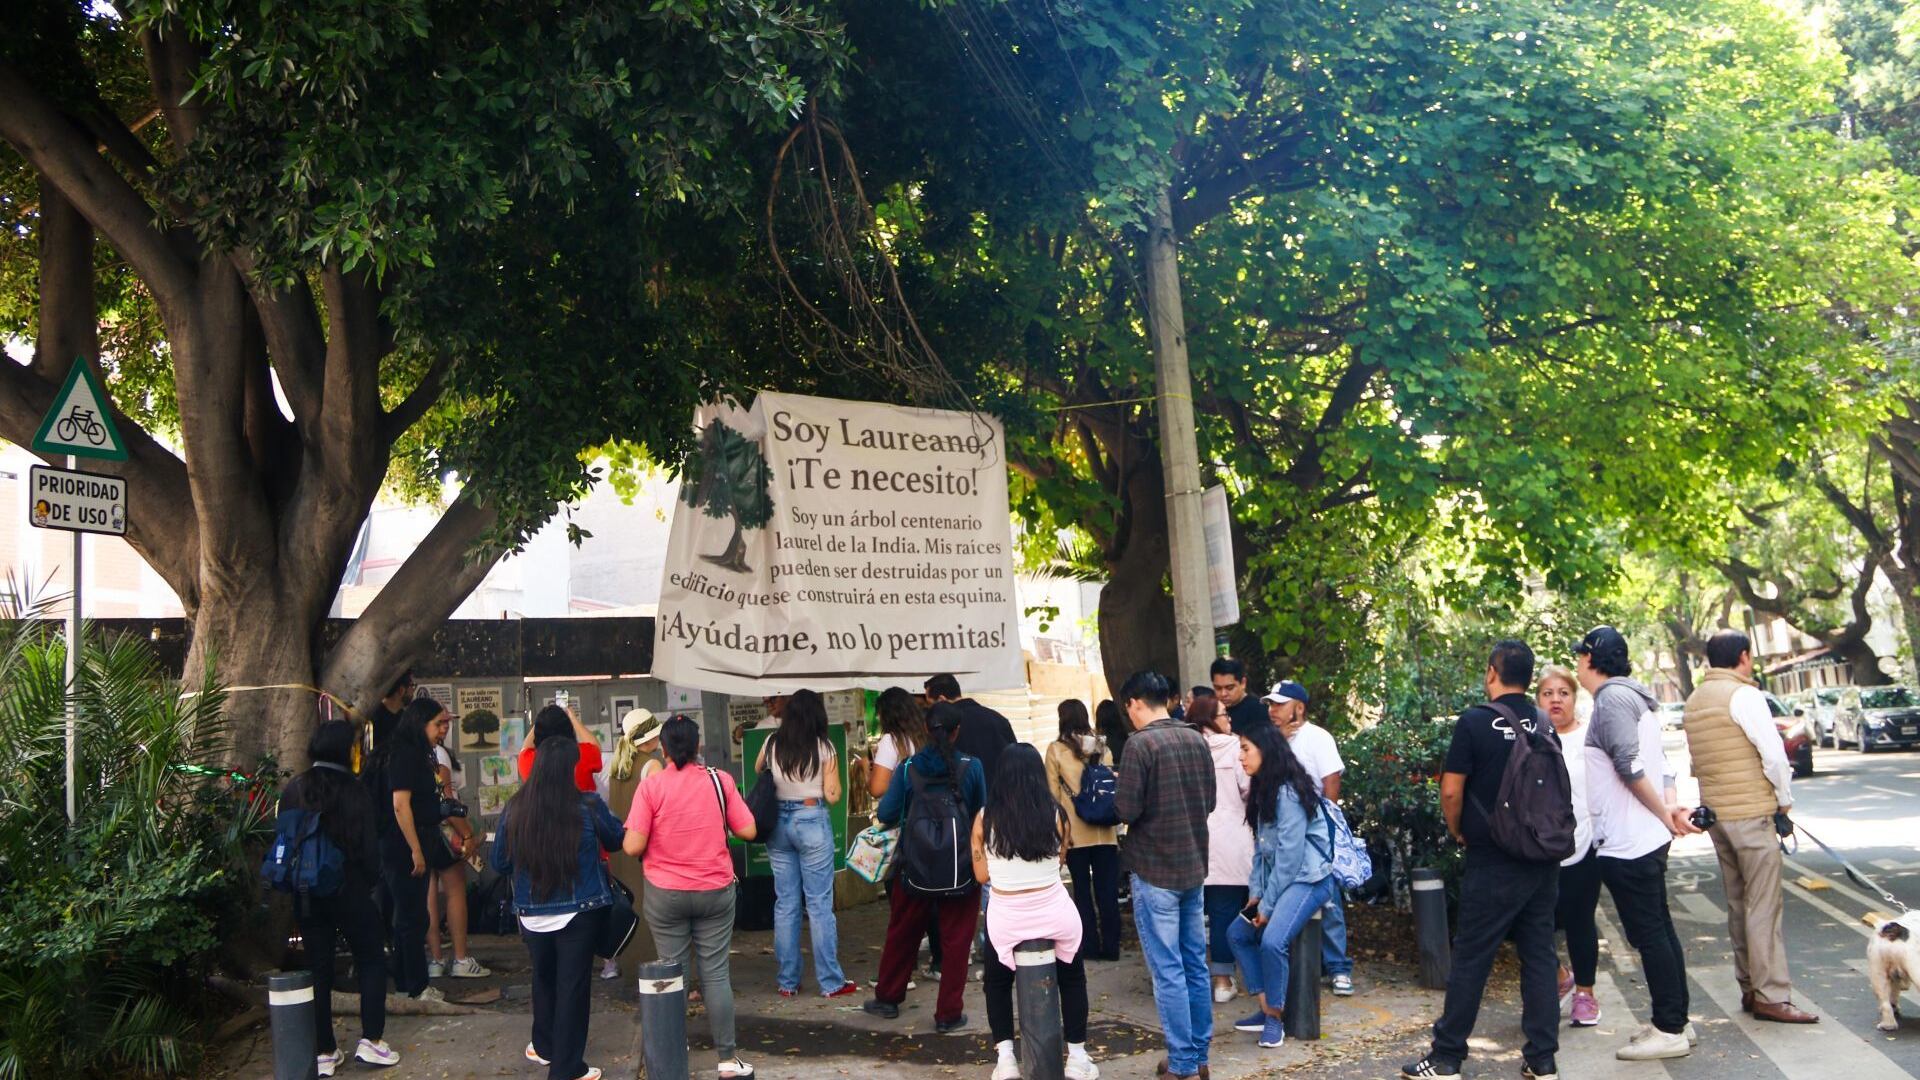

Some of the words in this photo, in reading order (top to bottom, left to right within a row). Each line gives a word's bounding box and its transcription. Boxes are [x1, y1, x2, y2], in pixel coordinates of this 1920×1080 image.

[773, 411, 830, 452] Soy
[838, 418, 985, 460] Laureano,
[39, 474, 119, 501] PRIORIDAD
[787, 457, 841, 489] ¡Te
[850, 465, 978, 496] necesito!
[52, 503, 71, 521] DE
[79, 506, 107, 526] USO
[791, 506, 818, 530] Soy
[822, 514, 845, 527] un
[850, 510, 896, 528] árbol
[900, 514, 982, 530] centenario
[776, 531, 823, 551] laurel
[826, 534, 846, 553] de
[851, 535, 867, 553] la
[872, 536, 920, 554] India.
[924, 538, 952, 554] Mis
[956, 539, 1001, 555] raíces
[770, 558, 831, 584] pueden
[834, 566, 857, 579] ser
[861, 561, 947, 579] destruidas
[951, 567, 979, 585] por
[984, 567, 1003, 579] un
[670, 572, 735, 602] edificio
[737, 591, 770, 610] que
[772, 591, 791, 605] se
[797, 587, 875, 605] construirá
[879, 592, 900, 605] en
[905, 591, 936, 605] esta
[939, 587, 1006, 609] esquina.
[661, 610, 818, 655] ¡Ayúdame,
[826, 630, 857, 650] no
[858, 623, 883, 651] lo
[888, 622, 1007, 660] permitas!
